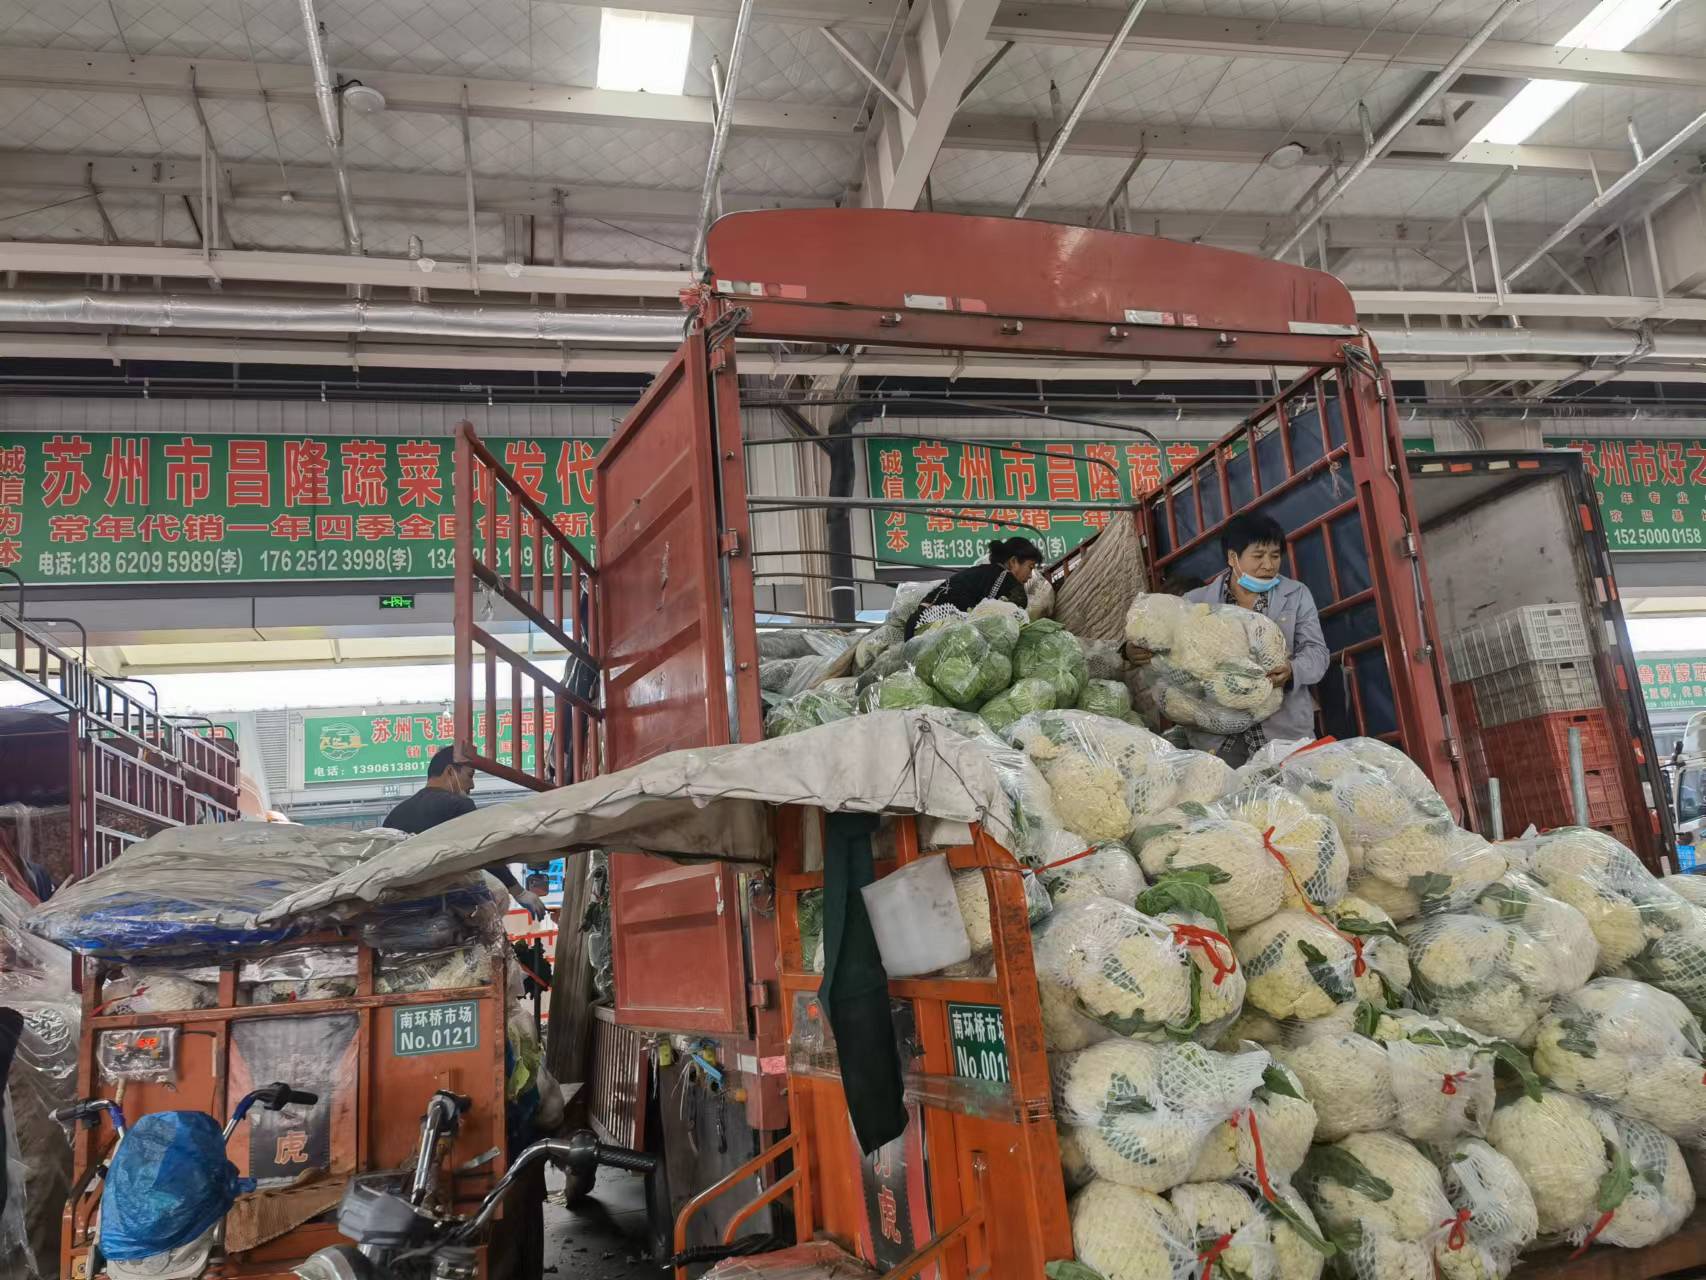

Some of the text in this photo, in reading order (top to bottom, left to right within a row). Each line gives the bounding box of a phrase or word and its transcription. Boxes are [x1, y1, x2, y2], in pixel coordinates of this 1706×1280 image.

[1614, 527, 1702, 545] 152 5000 0158
[116, 551, 163, 574] 6209
[260, 550, 292, 572] 176
[296, 550, 338, 571] 2512
[400, 1005, 473, 1030] 南环桥市场
[400, 1026, 472, 1051] No.0121
[956, 1045, 1010, 1083] No.001
